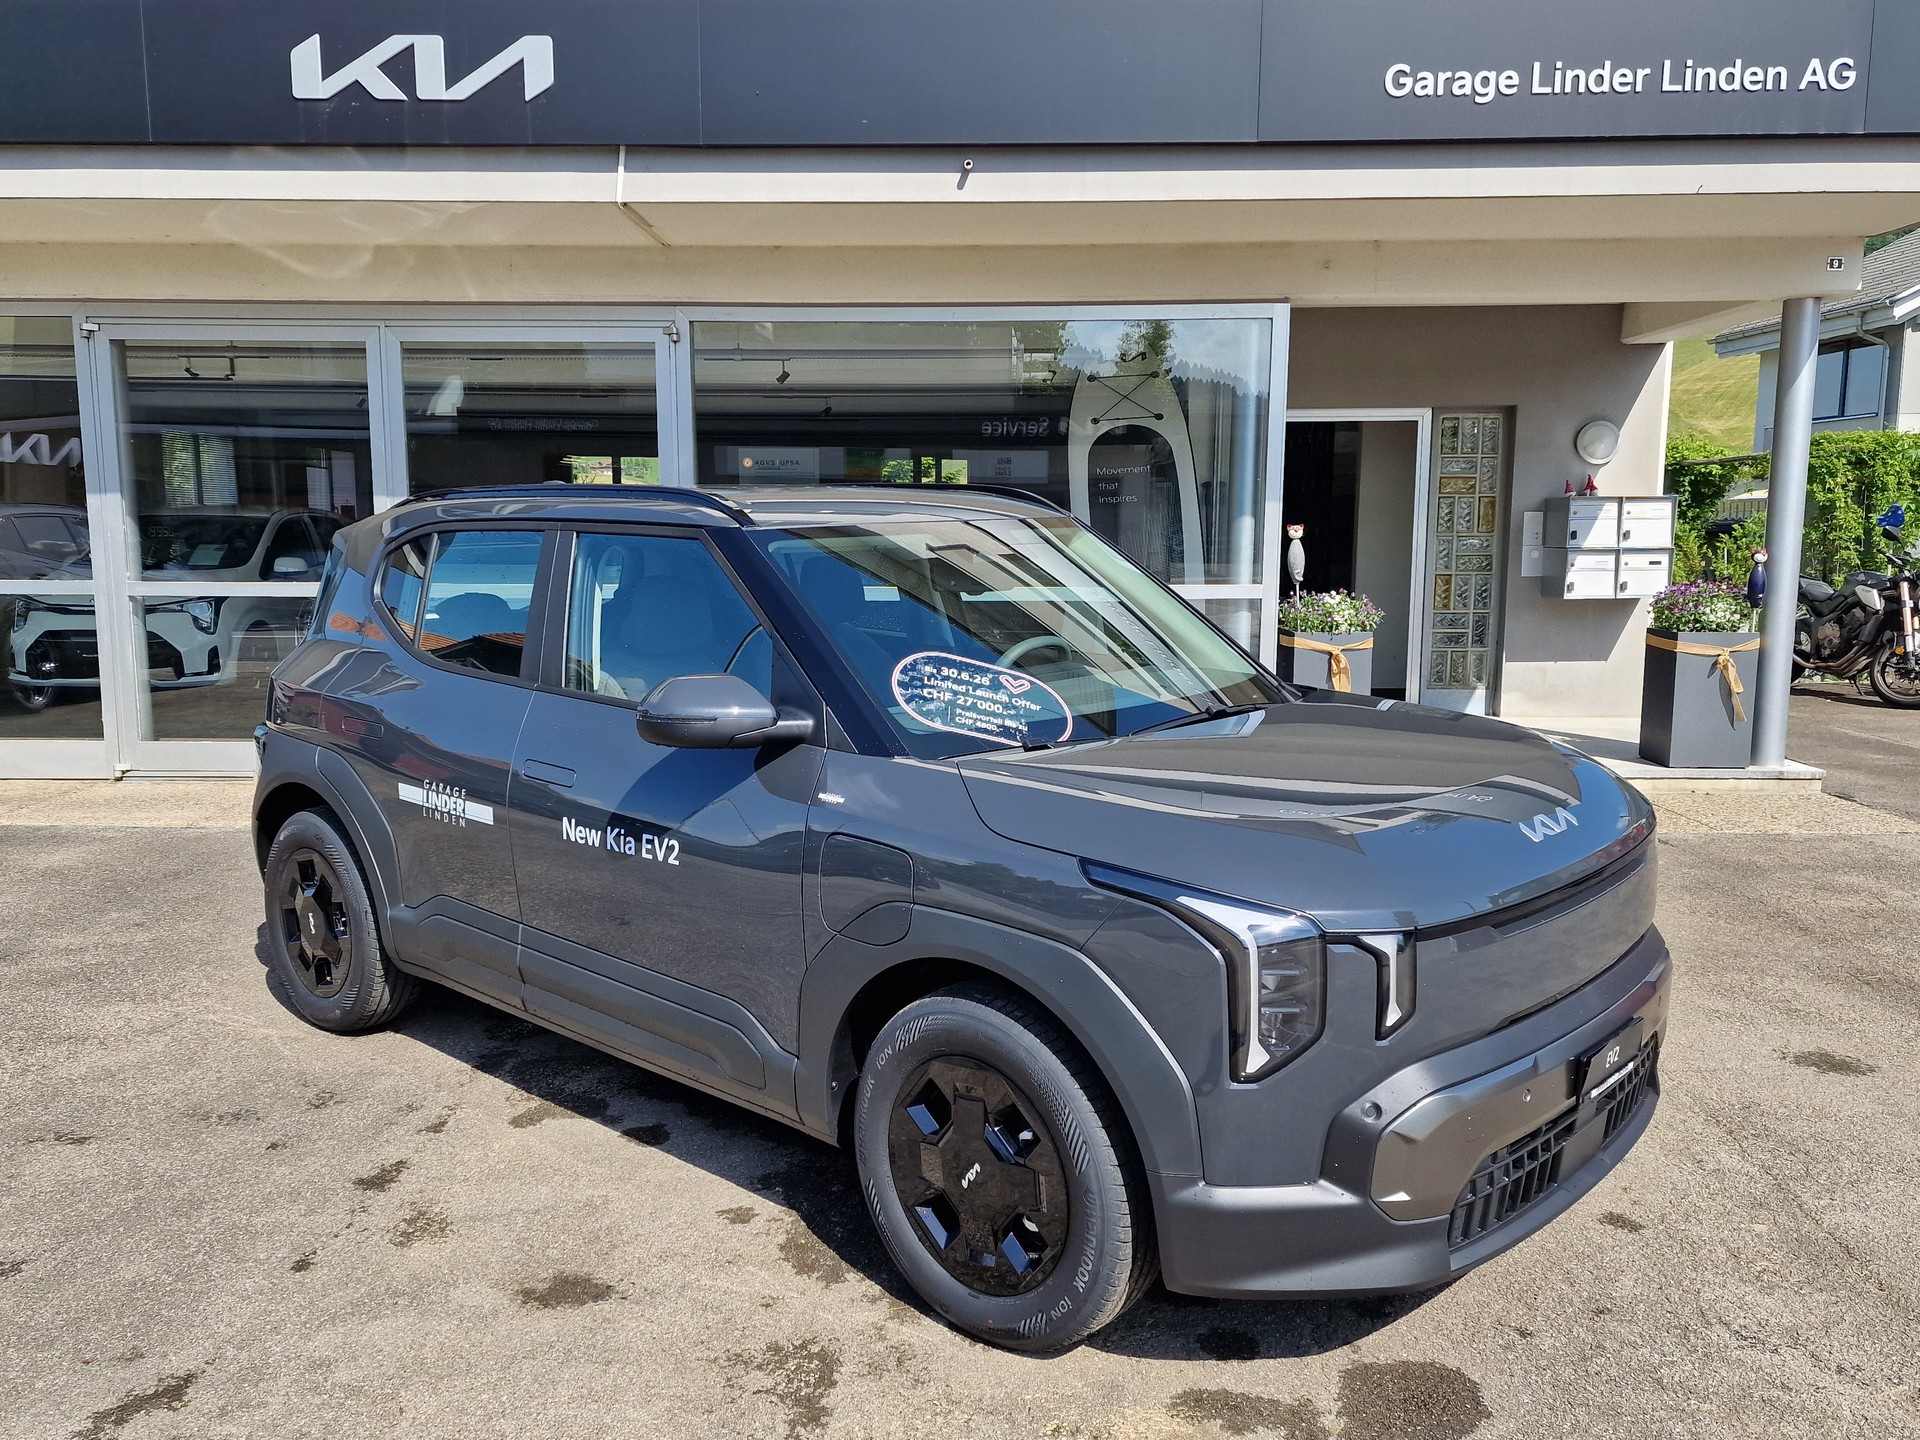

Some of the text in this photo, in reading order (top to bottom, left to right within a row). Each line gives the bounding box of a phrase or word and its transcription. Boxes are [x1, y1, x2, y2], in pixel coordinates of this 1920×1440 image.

[1384, 57, 1857, 104] Garage Linder Linden AG
[1833, 259, 1839, 268] 9
[1096, 465, 1150, 475] Movement
[1098, 482, 1119, 490] that
[1098, 495, 1138, 504] inspires
[940, 666, 990, 686] 30.6.26
[923, 676, 1042, 711] Limited Launch Offer
[923, 688, 954, 701] CHF
[955, 716, 974, 726] CHF
[423, 779, 466, 799] GARAGE
[423, 789, 465, 818] LINDER
[422, 806, 466, 828] LINDEN
[562, 816, 680, 866] New Kia EV2
[1605, 1045, 1620, 1069] EV2
